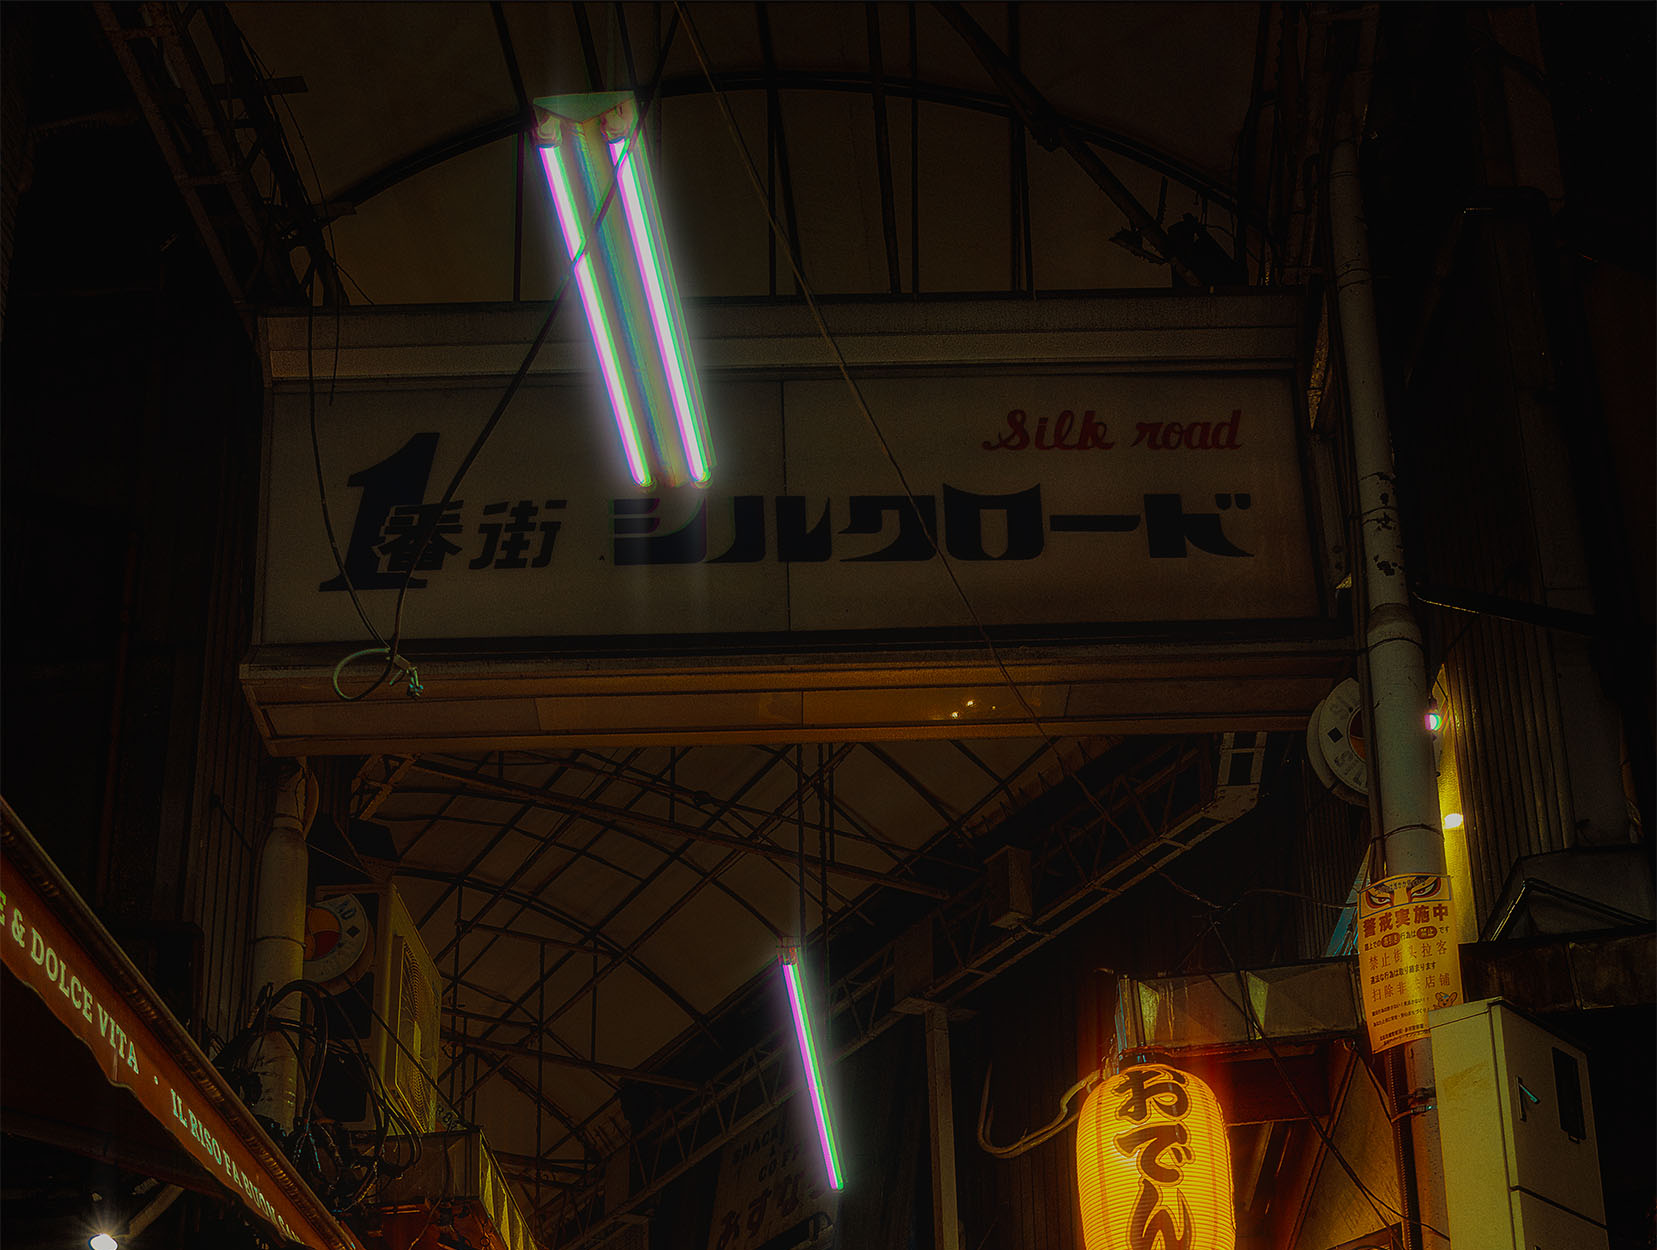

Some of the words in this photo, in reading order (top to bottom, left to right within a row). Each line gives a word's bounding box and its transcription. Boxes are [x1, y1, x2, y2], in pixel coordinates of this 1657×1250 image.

[982, 409, 1115, 451] Silk
[1130, 409, 1243, 451] road
[614, 483, 1255, 565] シルクロード
[1363, 903, 1449, 939] 警戒実施中
[30, 927, 94, 1024] DOLCE
[97, 1002, 140, 1075] VITA
[188, 1109, 222, 1166] RISO
